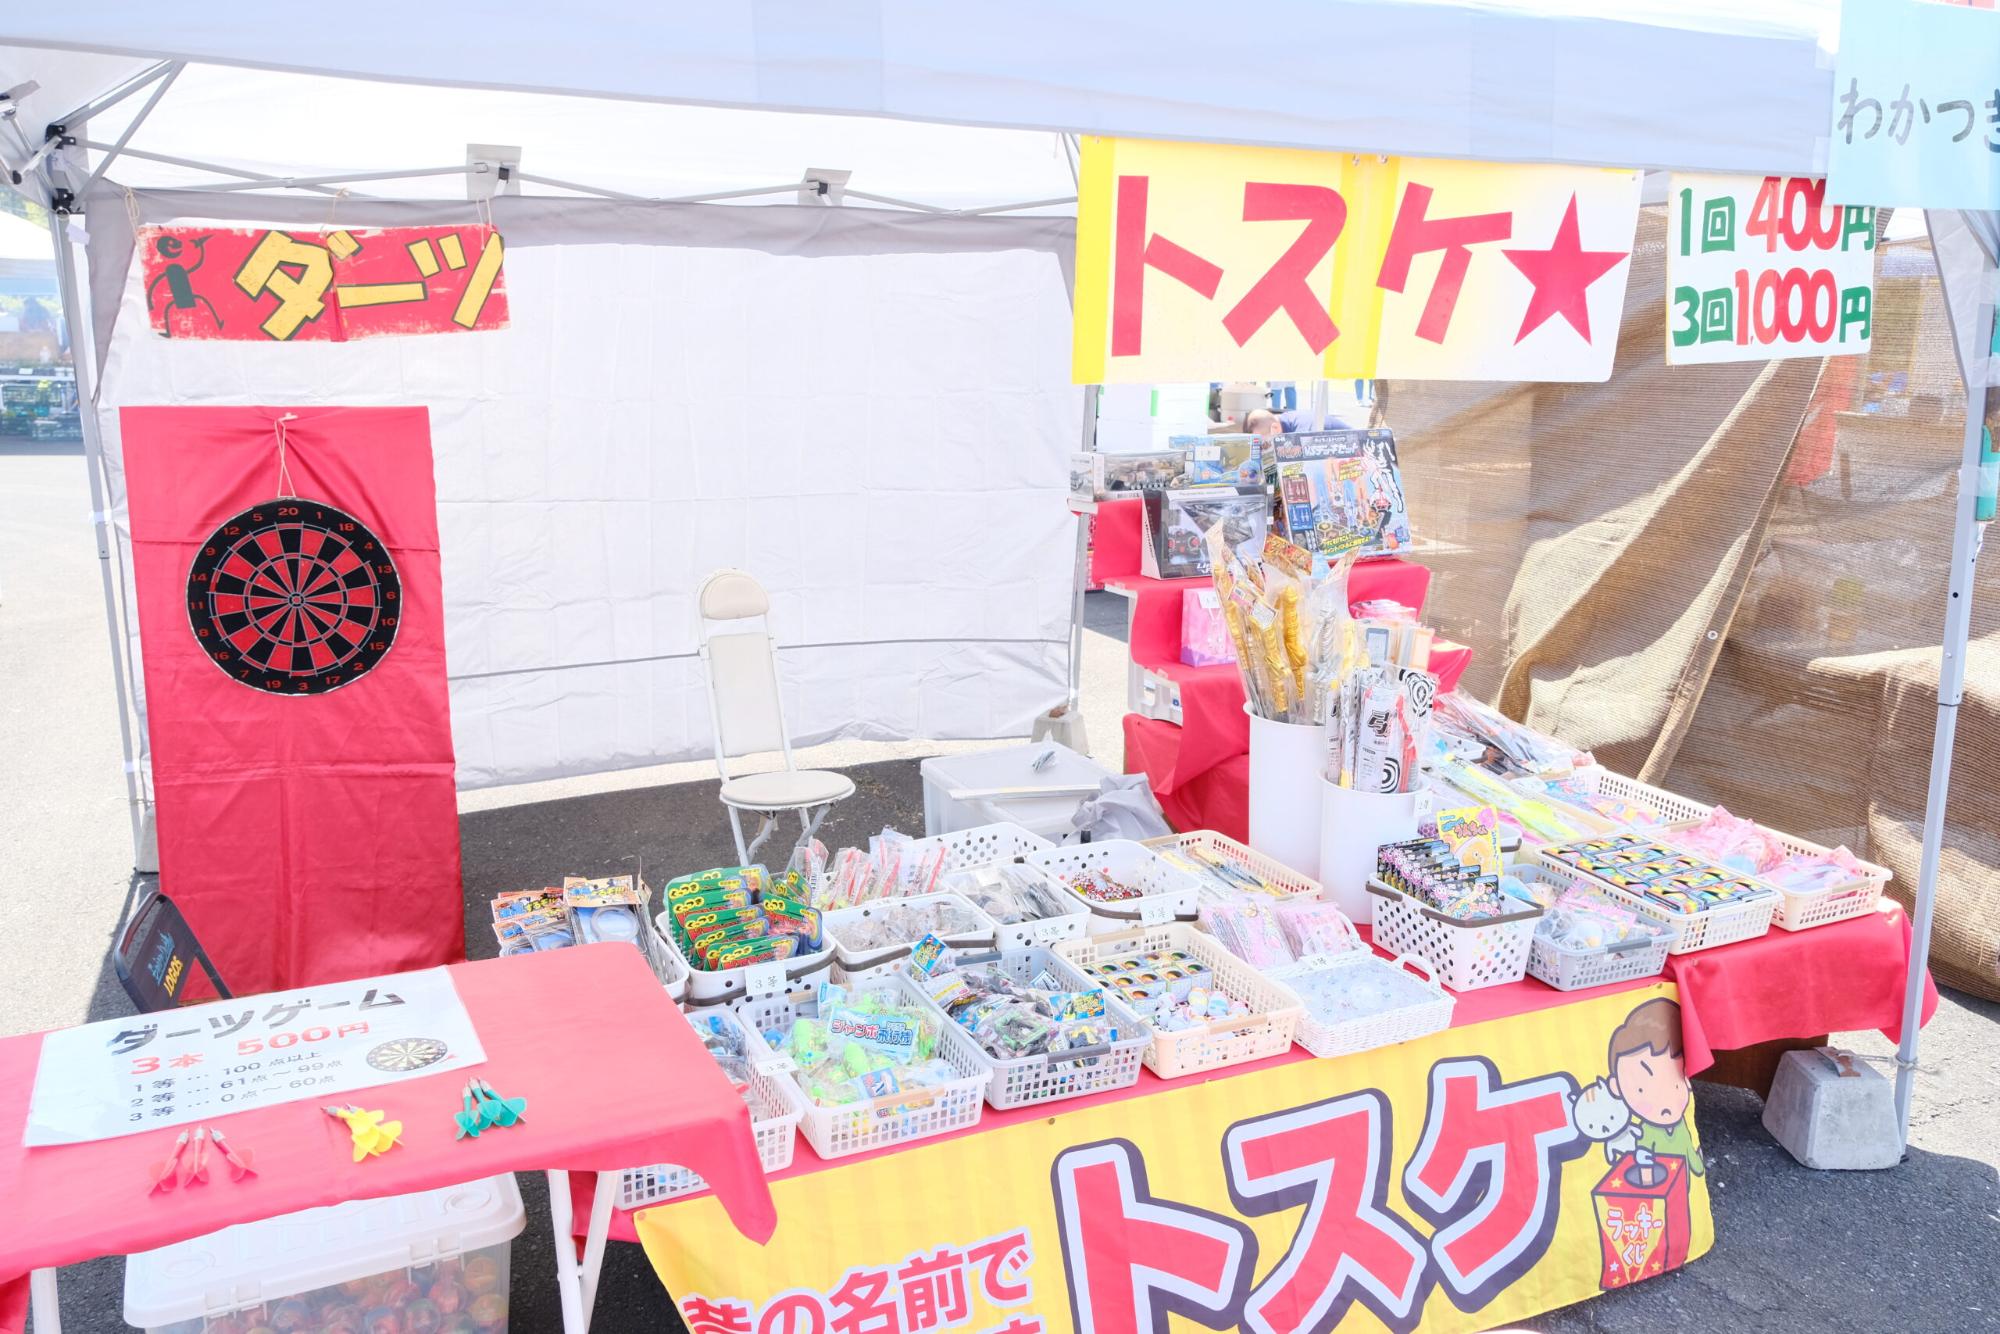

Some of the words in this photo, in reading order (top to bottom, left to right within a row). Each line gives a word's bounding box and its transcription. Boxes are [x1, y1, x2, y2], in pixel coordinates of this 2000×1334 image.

[1111, 174, 1513, 357] トスケ
[233, 229, 505, 342] ダーツ
[278, 507, 298, 516] 20
[316, 511, 323, 520] 1
[252, 513, 263, 522] 5
[224, 527, 240, 536] 12
[339, 523, 355, 532] 18
[364, 542, 374, 550] 4
[206, 547, 216, 556] 9
[377, 565, 393, 574] 13
[191, 573, 207, 582] 14
[381, 618, 396, 626] 10
[370, 642, 385, 651] 15
[214, 652, 229, 661] 16
[354, 662, 364, 671] 2
[240, 669, 250, 678] 7
[265, 680, 282, 689] 19
[325, 676, 341, 685] 17
[299, 682, 309, 691] 3
[163, 955, 184, 998] LOGOS
[106, 988, 406, 1056] ダーツゲーム
[130, 1052, 204, 1075] 3本
[236, 1020, 370, 1056] 500円
[1056, 1060, 1578, 1334] トスケ
[1606, 1204, 1663, 1241] ラッキー
[1622, 1242, 1648, 1266] くじ
